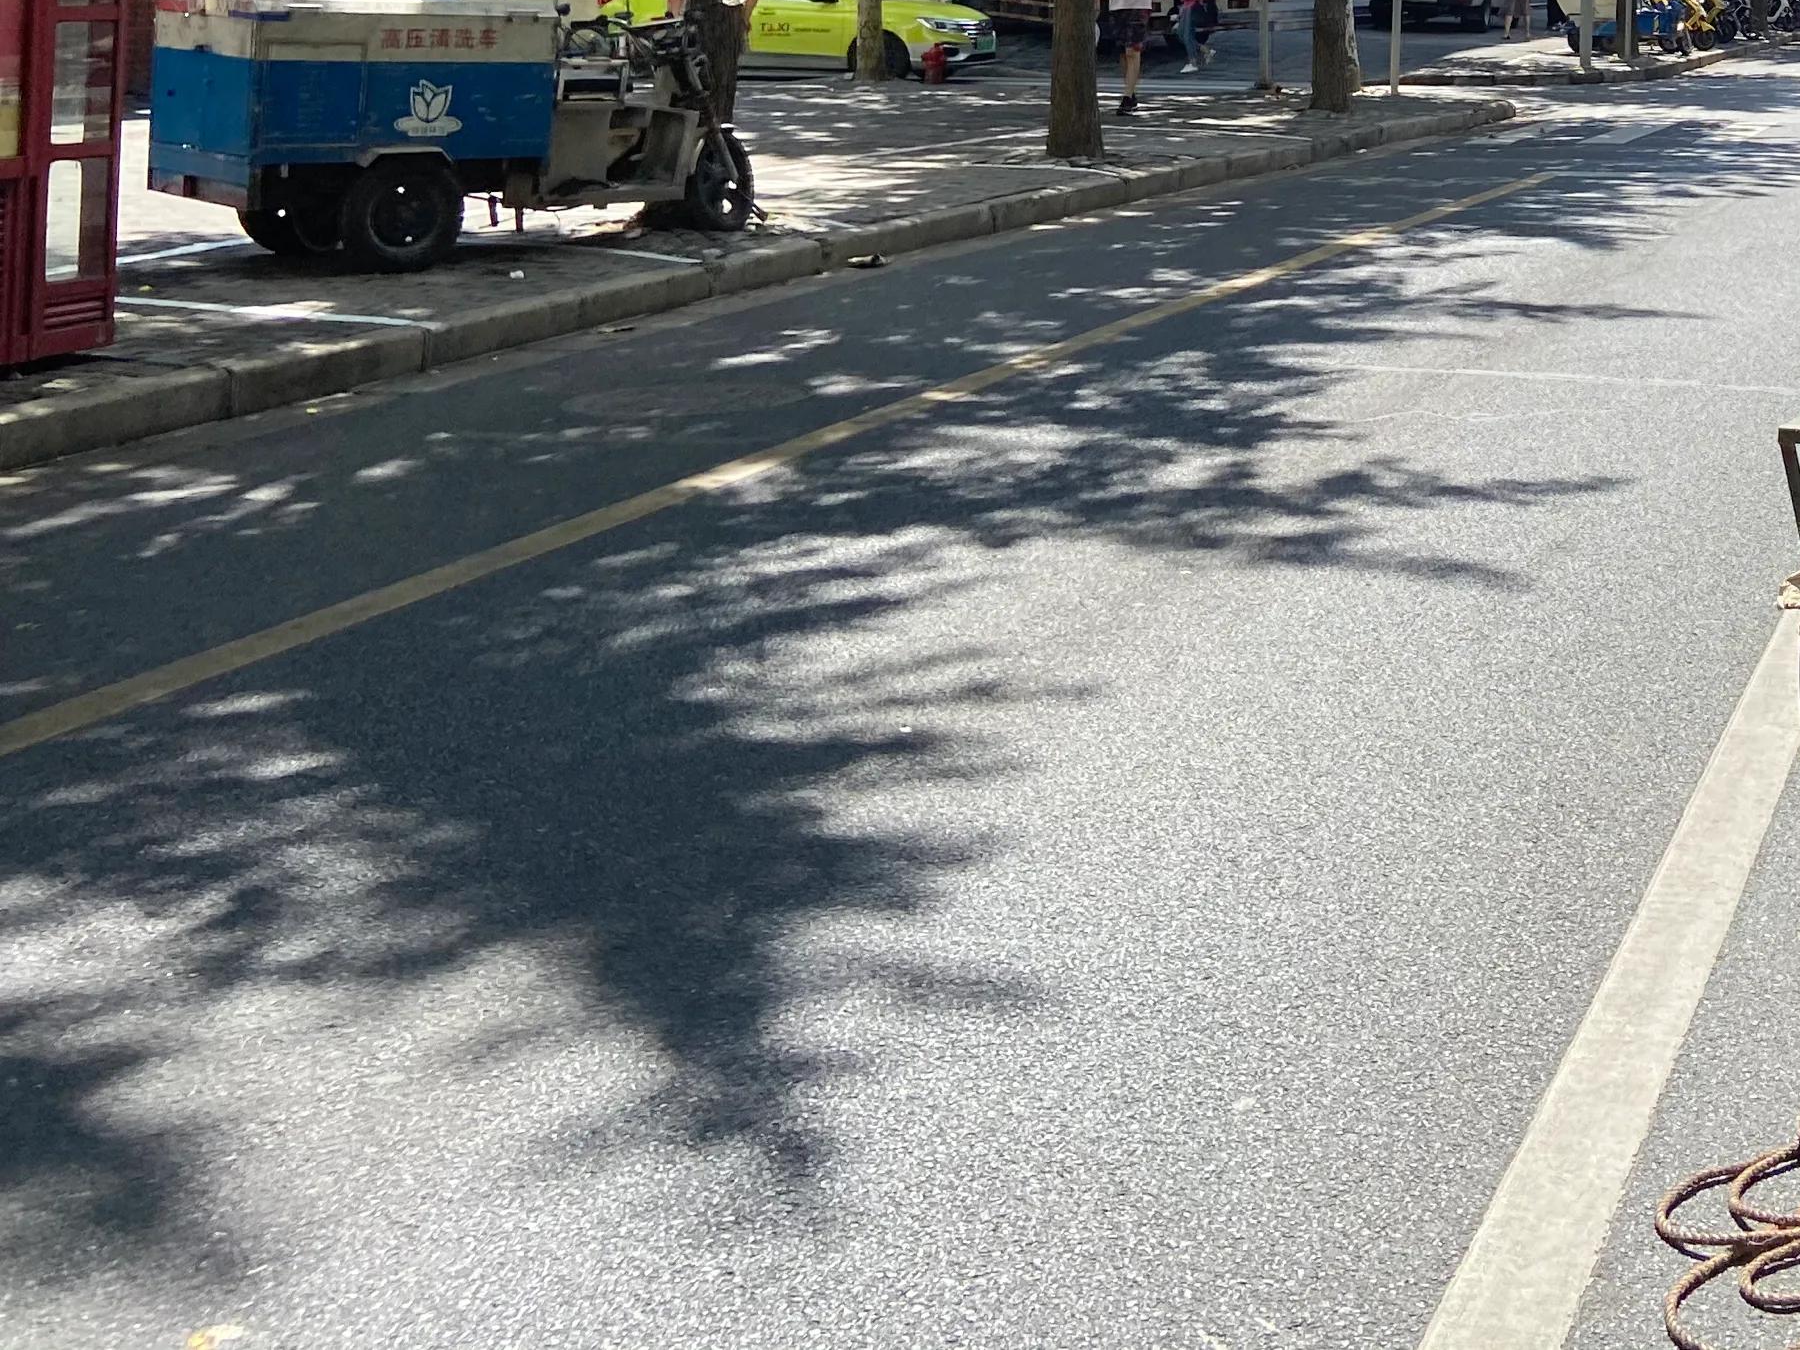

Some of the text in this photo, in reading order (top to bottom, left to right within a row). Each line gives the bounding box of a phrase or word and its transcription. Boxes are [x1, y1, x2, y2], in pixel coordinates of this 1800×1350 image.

[381, 27, 498, 49] 高压清洗车
